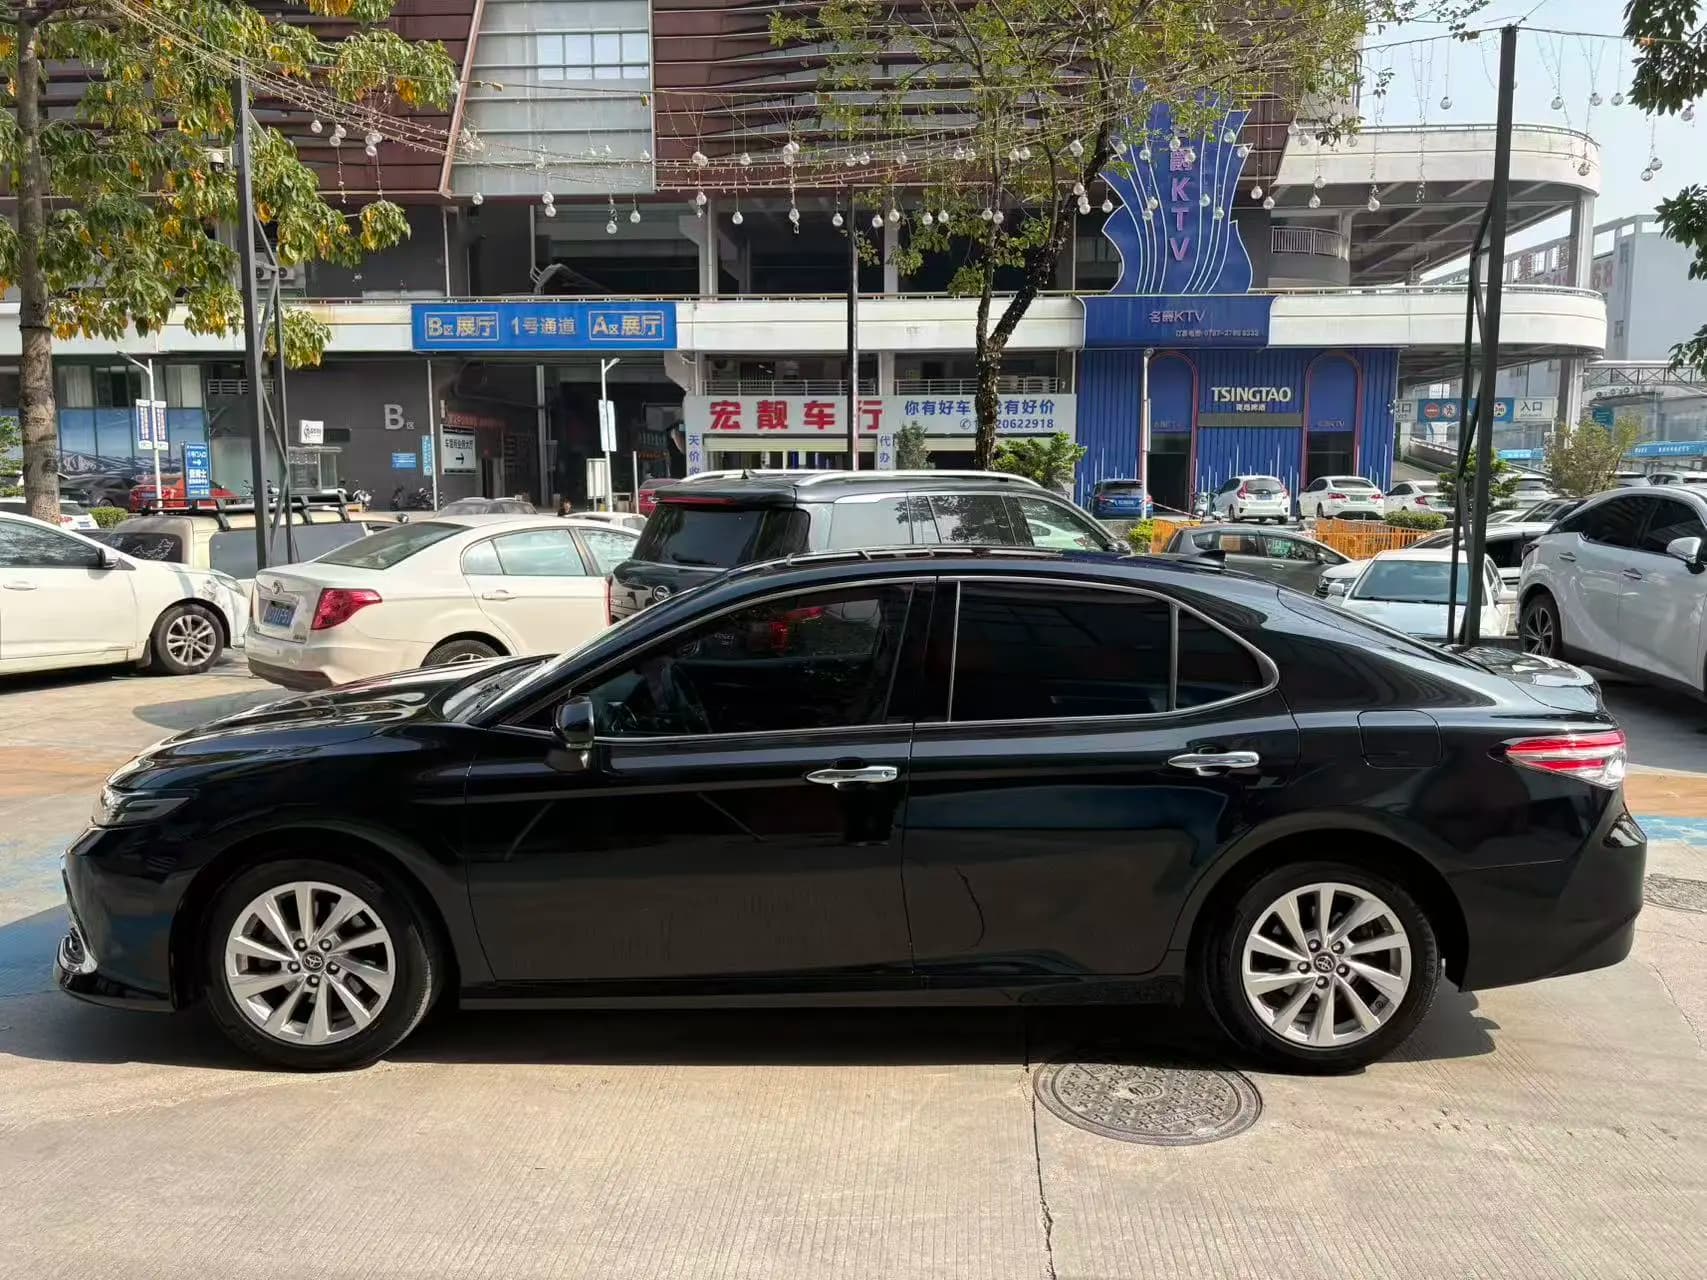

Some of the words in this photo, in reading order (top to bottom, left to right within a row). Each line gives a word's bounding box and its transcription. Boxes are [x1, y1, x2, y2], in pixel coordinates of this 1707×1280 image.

[428, 316, 496, 336] B区展厅
[512, 316, 576, 336] 1号通道
[592, 315, 661, 336] A区展厅
[1211, 387, 1291, 402] TSINGTAO
[905, 400, 971, 416] 你有好车
[1520, 401, 1542, 411] 入口
[710, 400, 882, 430] 宏靓车行
[974, 418, 1054, 429] 120622918
